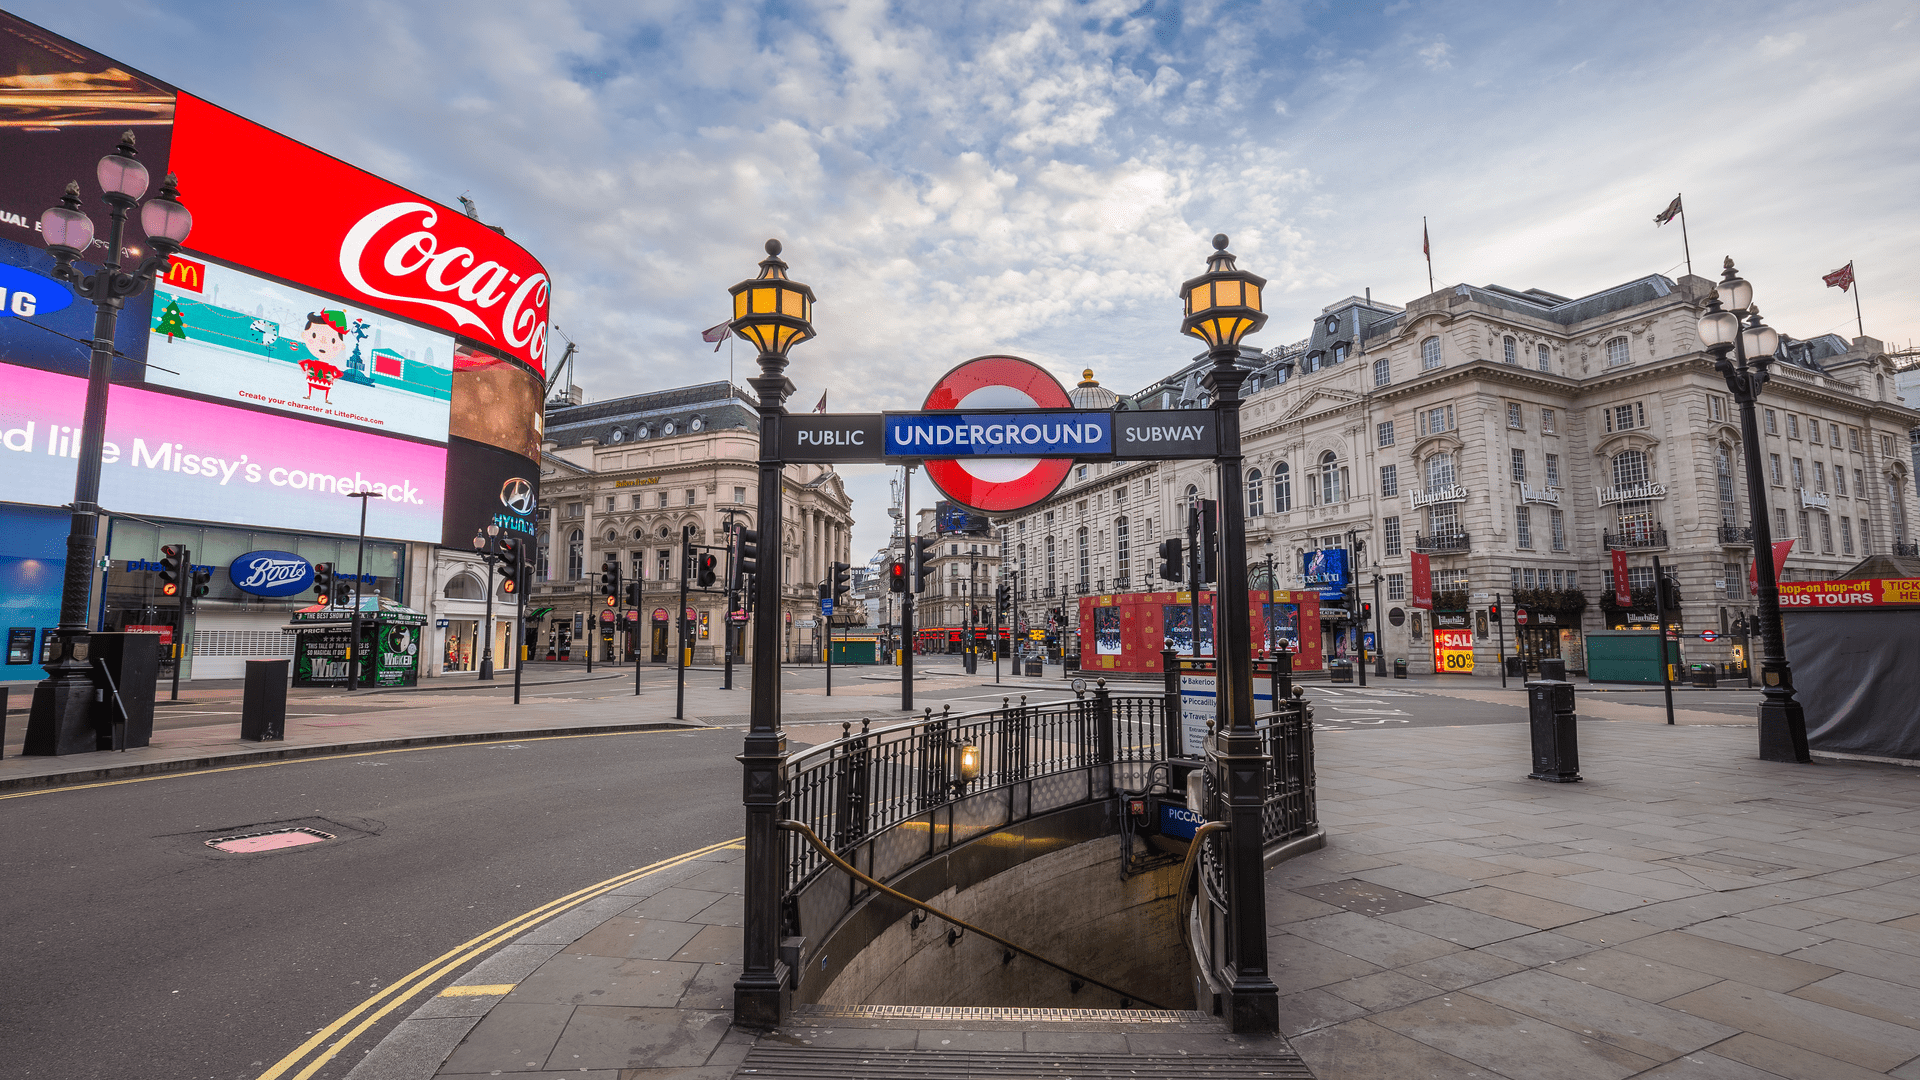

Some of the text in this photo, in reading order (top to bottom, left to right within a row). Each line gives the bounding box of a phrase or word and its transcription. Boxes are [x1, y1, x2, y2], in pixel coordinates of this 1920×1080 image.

[238, 390, 266, 401] Create
[287, 400, 323, 413] character
[797, 423, 1205, 446] PUBLIC UNDERGROUND SUBWAY
[268, 472, 424, 505] comeback.
[239, 557, 306, 588] Boots
[1780, 580, 1870, 595] hop-on hop-off
[1779, 593, 1874, 605] BUS TOURS
[1188, 677, 1215, 686] Bakerloo
[1189, 697, 1217, 707] Piccadilly
[1189, 712, 1207, 720] Travel
